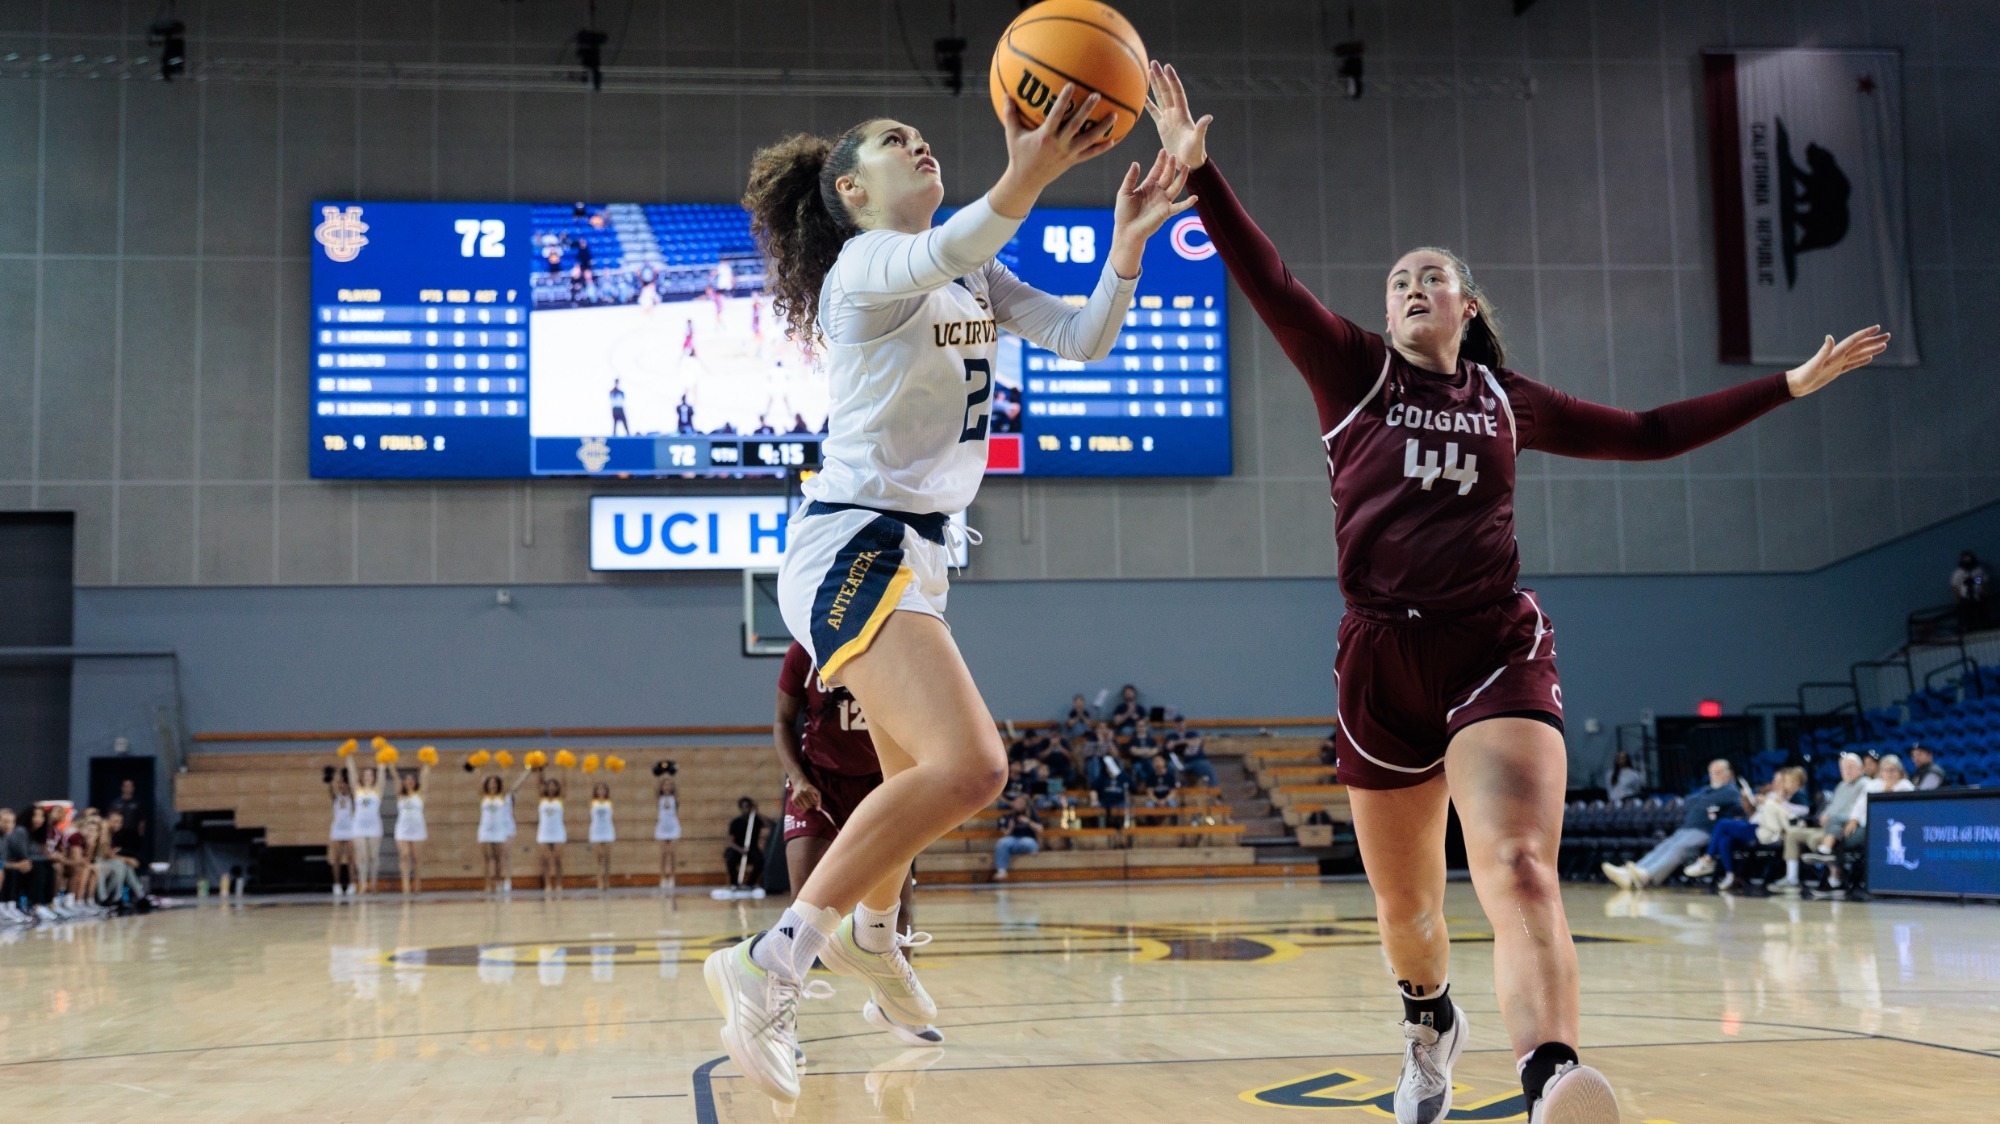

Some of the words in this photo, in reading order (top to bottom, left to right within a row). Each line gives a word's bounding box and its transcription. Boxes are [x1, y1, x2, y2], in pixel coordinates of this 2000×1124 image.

[1751, 121, 1770, 206] CALIFORNIA
[454, 219, 505, 257] 72
[1043, 226, 1095, 263] 48
[1756, 217, 1774, 286] REPUBLIC
[933, 321, 961, 347] UC
[958, 358, 991, 443] 2
[1386, 403, 1497, 437] COLGATE
[379, 435, 427, 451] FOULS:
[668, 444, 697, 466] 72
[711, 447, 739, 462] 4TH
[758, 443, 805, 465] 4:15
[1088, 436, 1134, 452] FOULS:
[1404, 438, 1479, 496] 44
[613, 512, 719, 555] UCI
[837, 700, 869, 731] 12
[1922, 826, 1958, 842] TOWER
